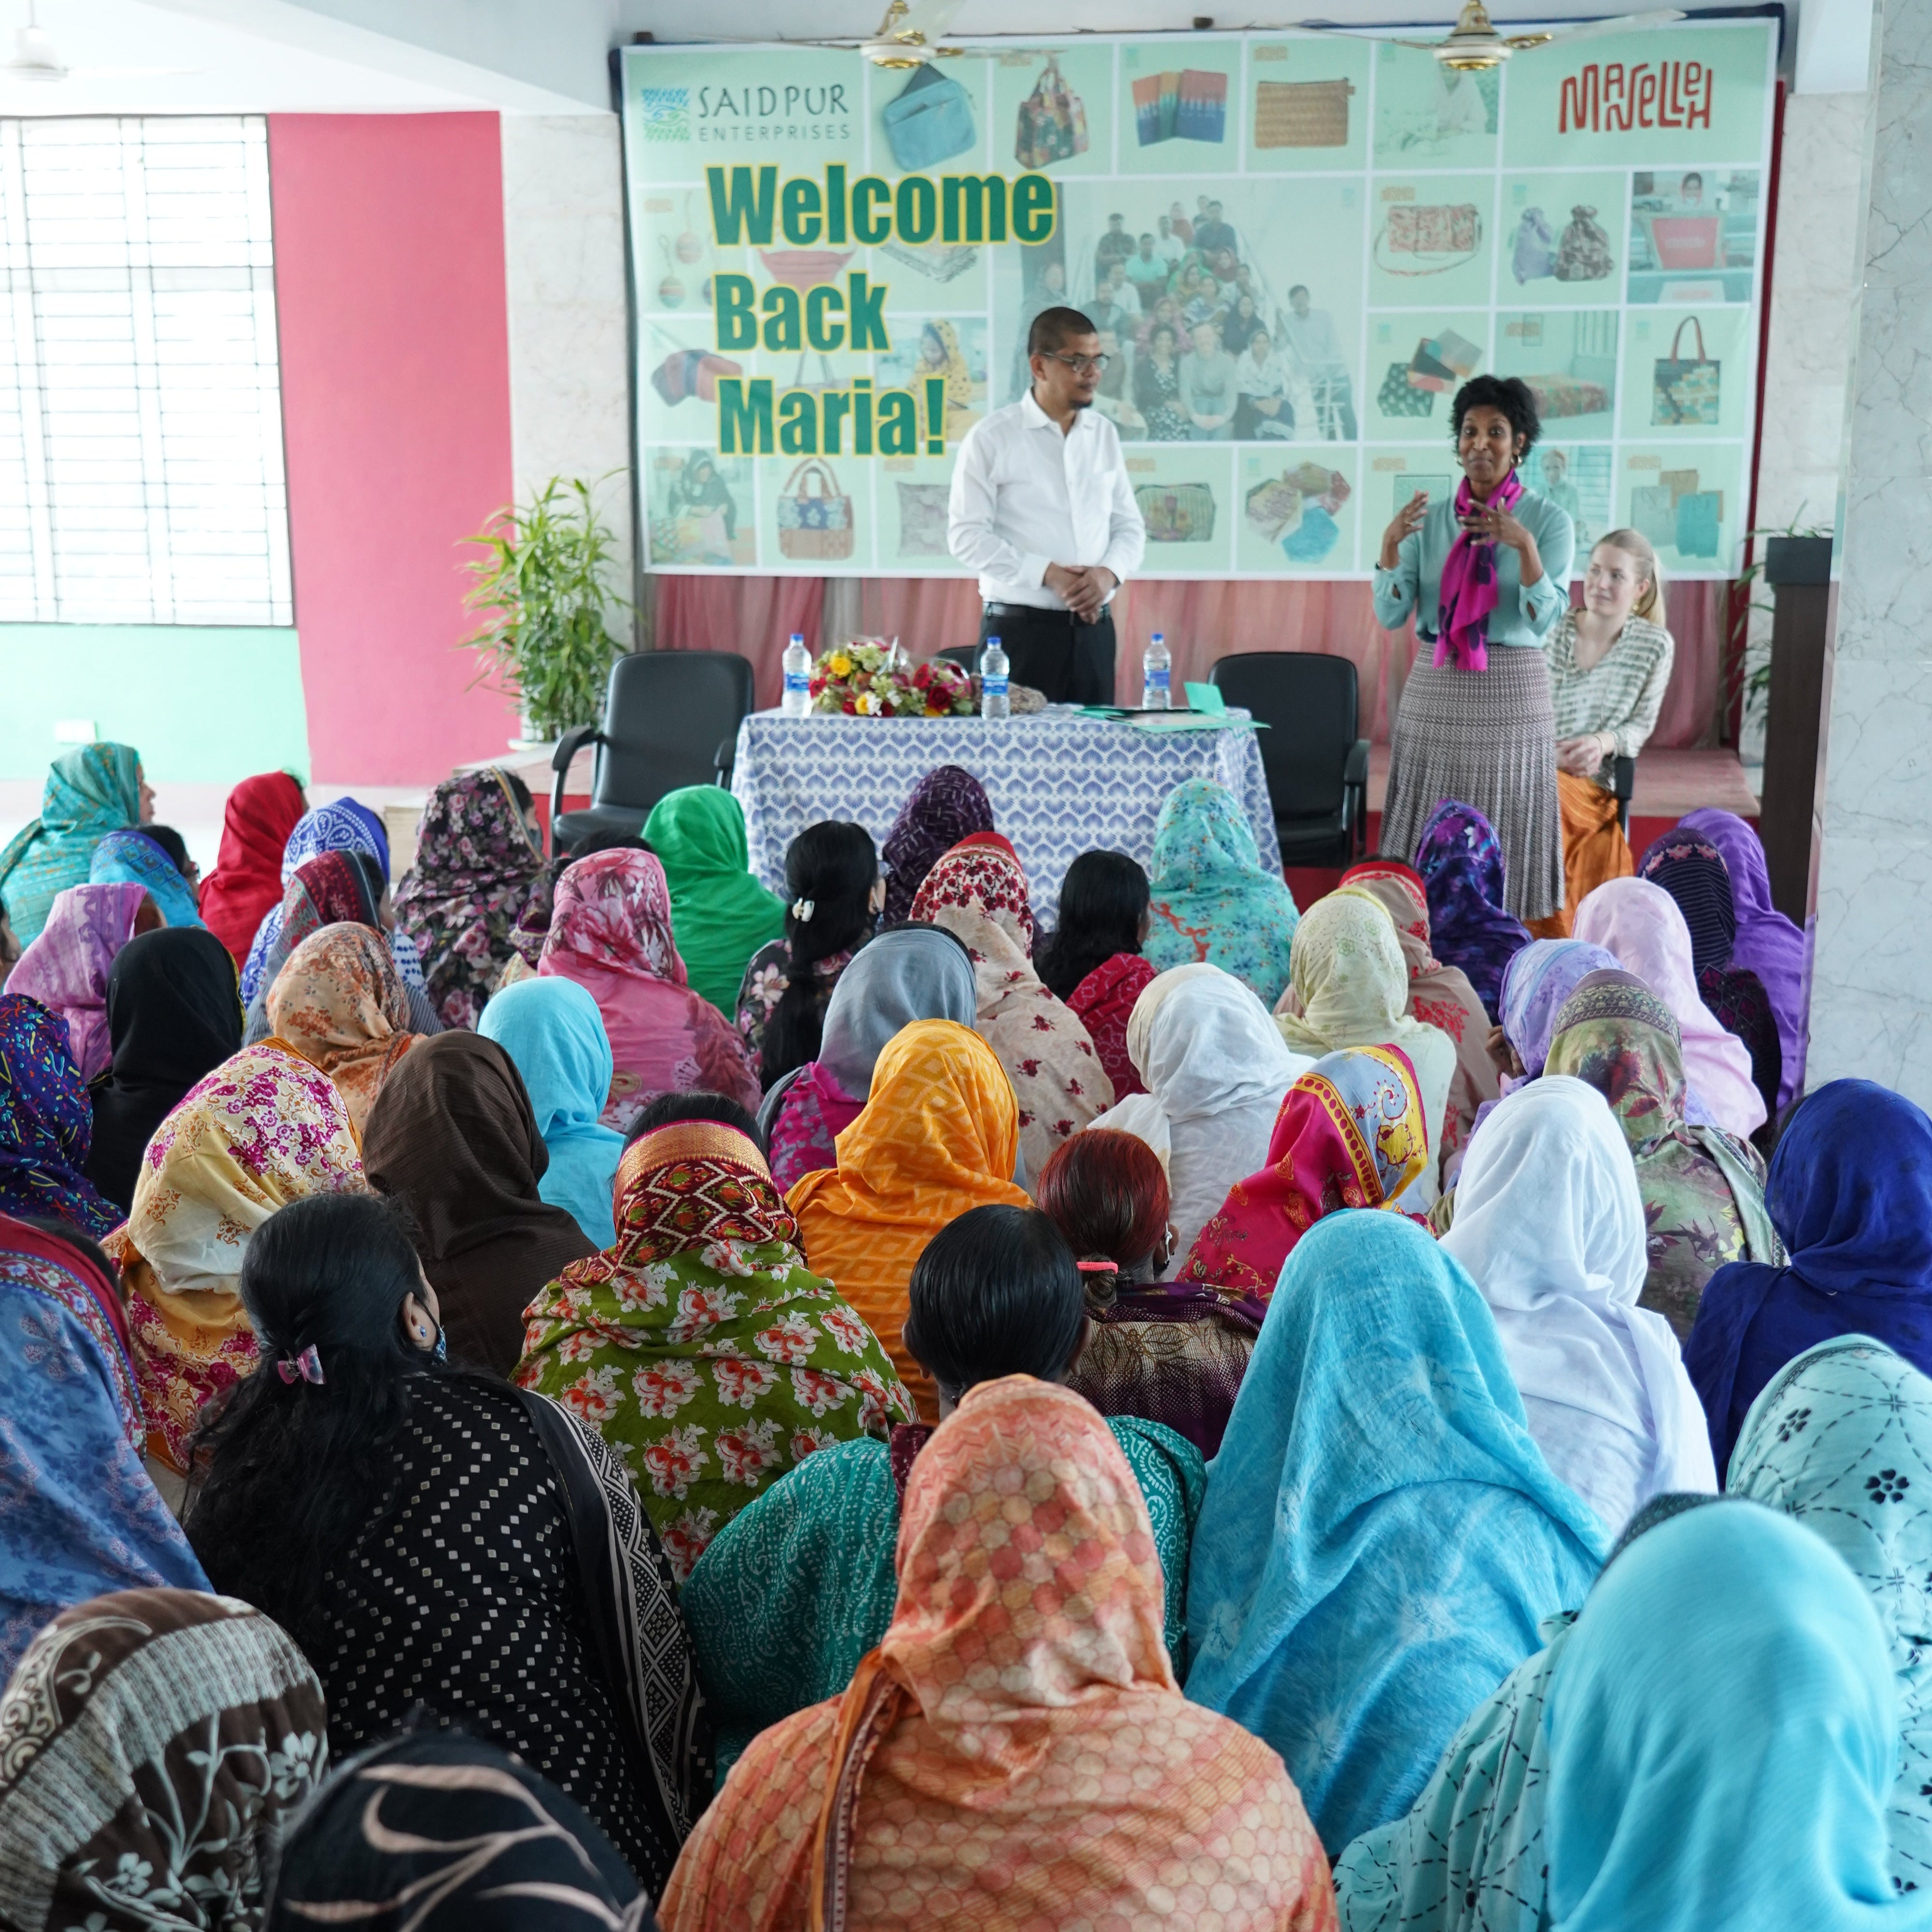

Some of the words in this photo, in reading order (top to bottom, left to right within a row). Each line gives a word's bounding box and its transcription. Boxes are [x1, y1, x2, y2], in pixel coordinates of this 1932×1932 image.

[698, 83, 849, 118] SAIDPUR
[698, 122, 850, 142] ENTERPRISES
[705, 162, 1057, 248] Welcome
[710, 270, 892, 353] Back
[715, 375, 947, 457] Maria!
